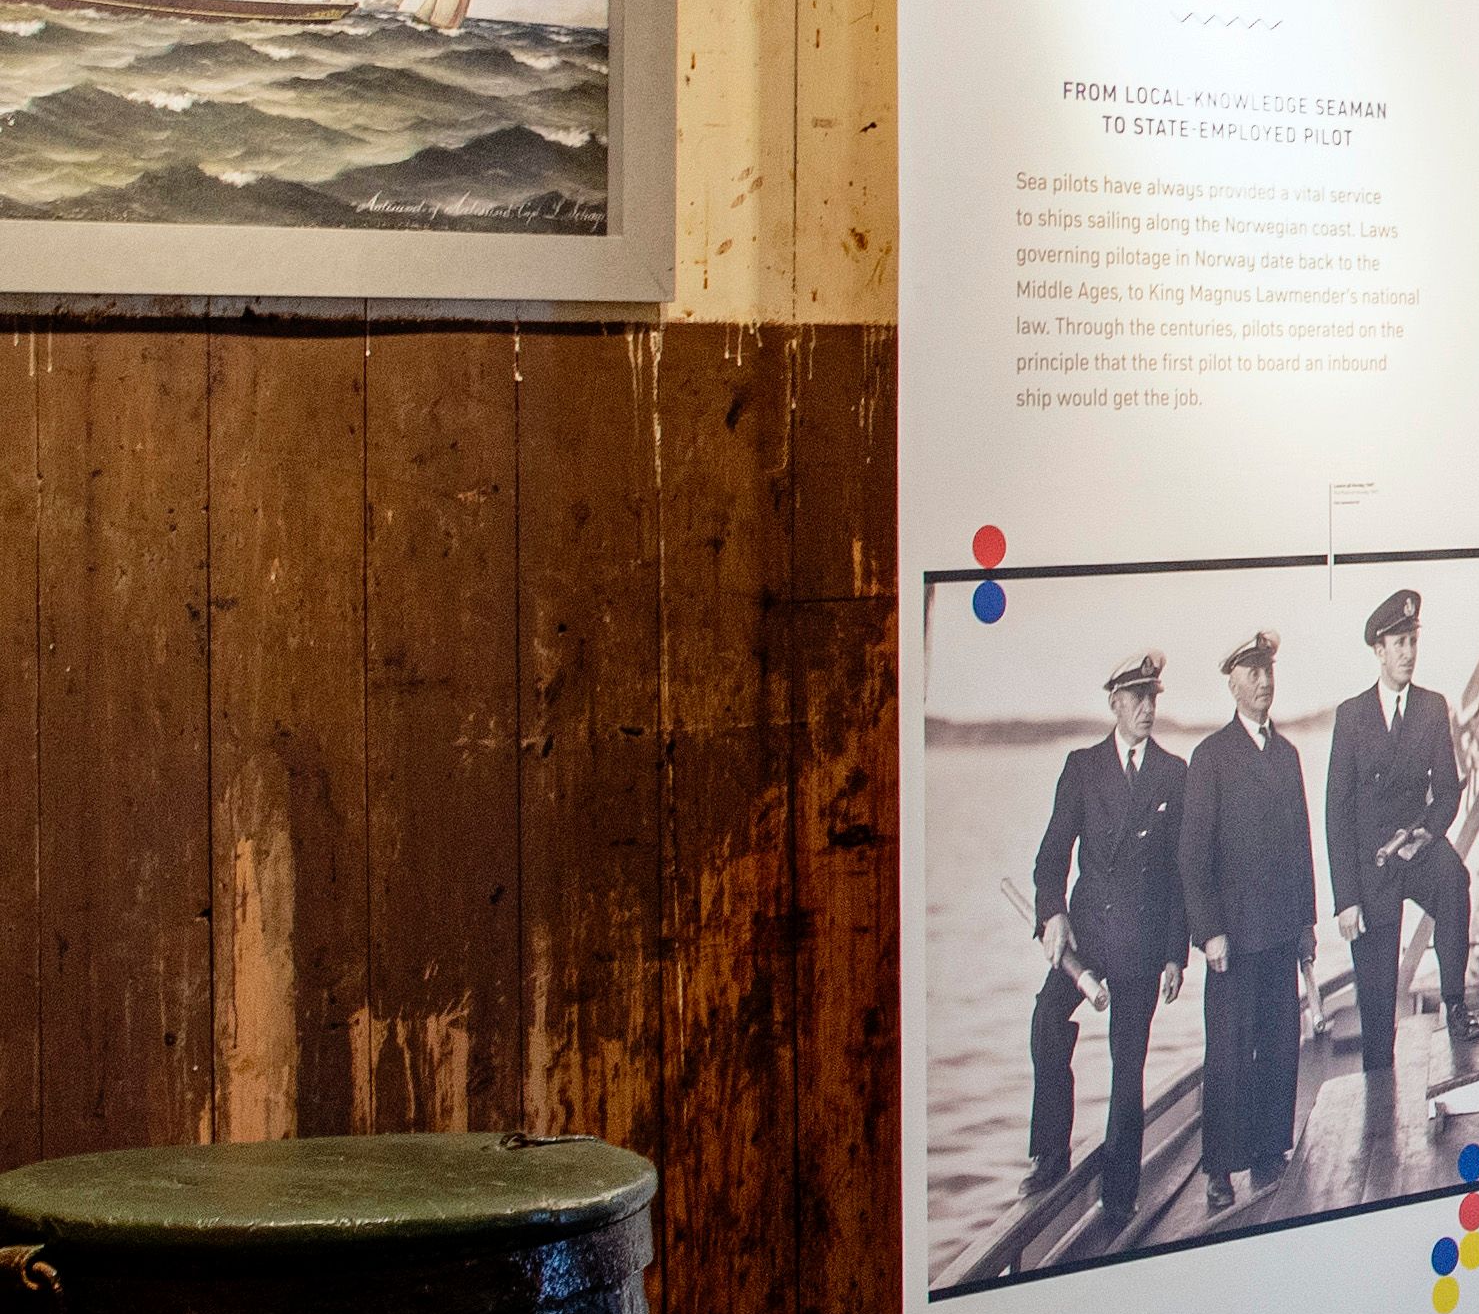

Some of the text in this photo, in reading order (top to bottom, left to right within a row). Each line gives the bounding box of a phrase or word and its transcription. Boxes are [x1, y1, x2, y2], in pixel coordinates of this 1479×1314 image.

[1062, 81, 1388, 119] FROM LOCAL-KNOWLEDGE SEAMAN
[1102, 114, 1353, 147] TO STATE-EMPLOYED PILOT
[1016, 170, 1048, 191] Sea
[1052, 172, 1099, 194] pilots
[1103, 174, 1142, 195] have
[1146, 178, 1204, 201] always
[1208, 183, 1276, 201] provided
[1330, 189, 1382, 205] service
[1016, 208, 1033, 227] to
[1037, 207, 1083, 231] ships
[1087, 210, 1141, 234] sailing
[1145, 213, 1190, 236] along
[1194, 214, 1220, 233] the
[1225, 216, 1307, 238] Norwegian
[1360, 221, 1399, 239] Laws
[1016, 246, 1380, 272] governing pilotage in Norway date back to the
[1016, 279, 1073, 299] Middle
[1077, 281, 1123, 304] Ages,
[1127, 283, 1144, 301] to
[1148, 283, 1185, 306] King
[1190, 284, 1252, 306] Magnus
[1361, 287, 1420, 306] national
[1016, 315, 1050, 335] law.
[1054, 316, 1124, 340] Through
[1129, 317, 1155, 336] the
[1241, 319, 1284, 340] pilots
[1287, 320, 1355, 339] operated
[1358, 323, 1377, 339] on
[1380, 320, 1404, 338] the
[1016, 351, 1388, 374] principle that the first pilot to board an inbound
[1016, 387, 1202, 411] ship would get the job.
